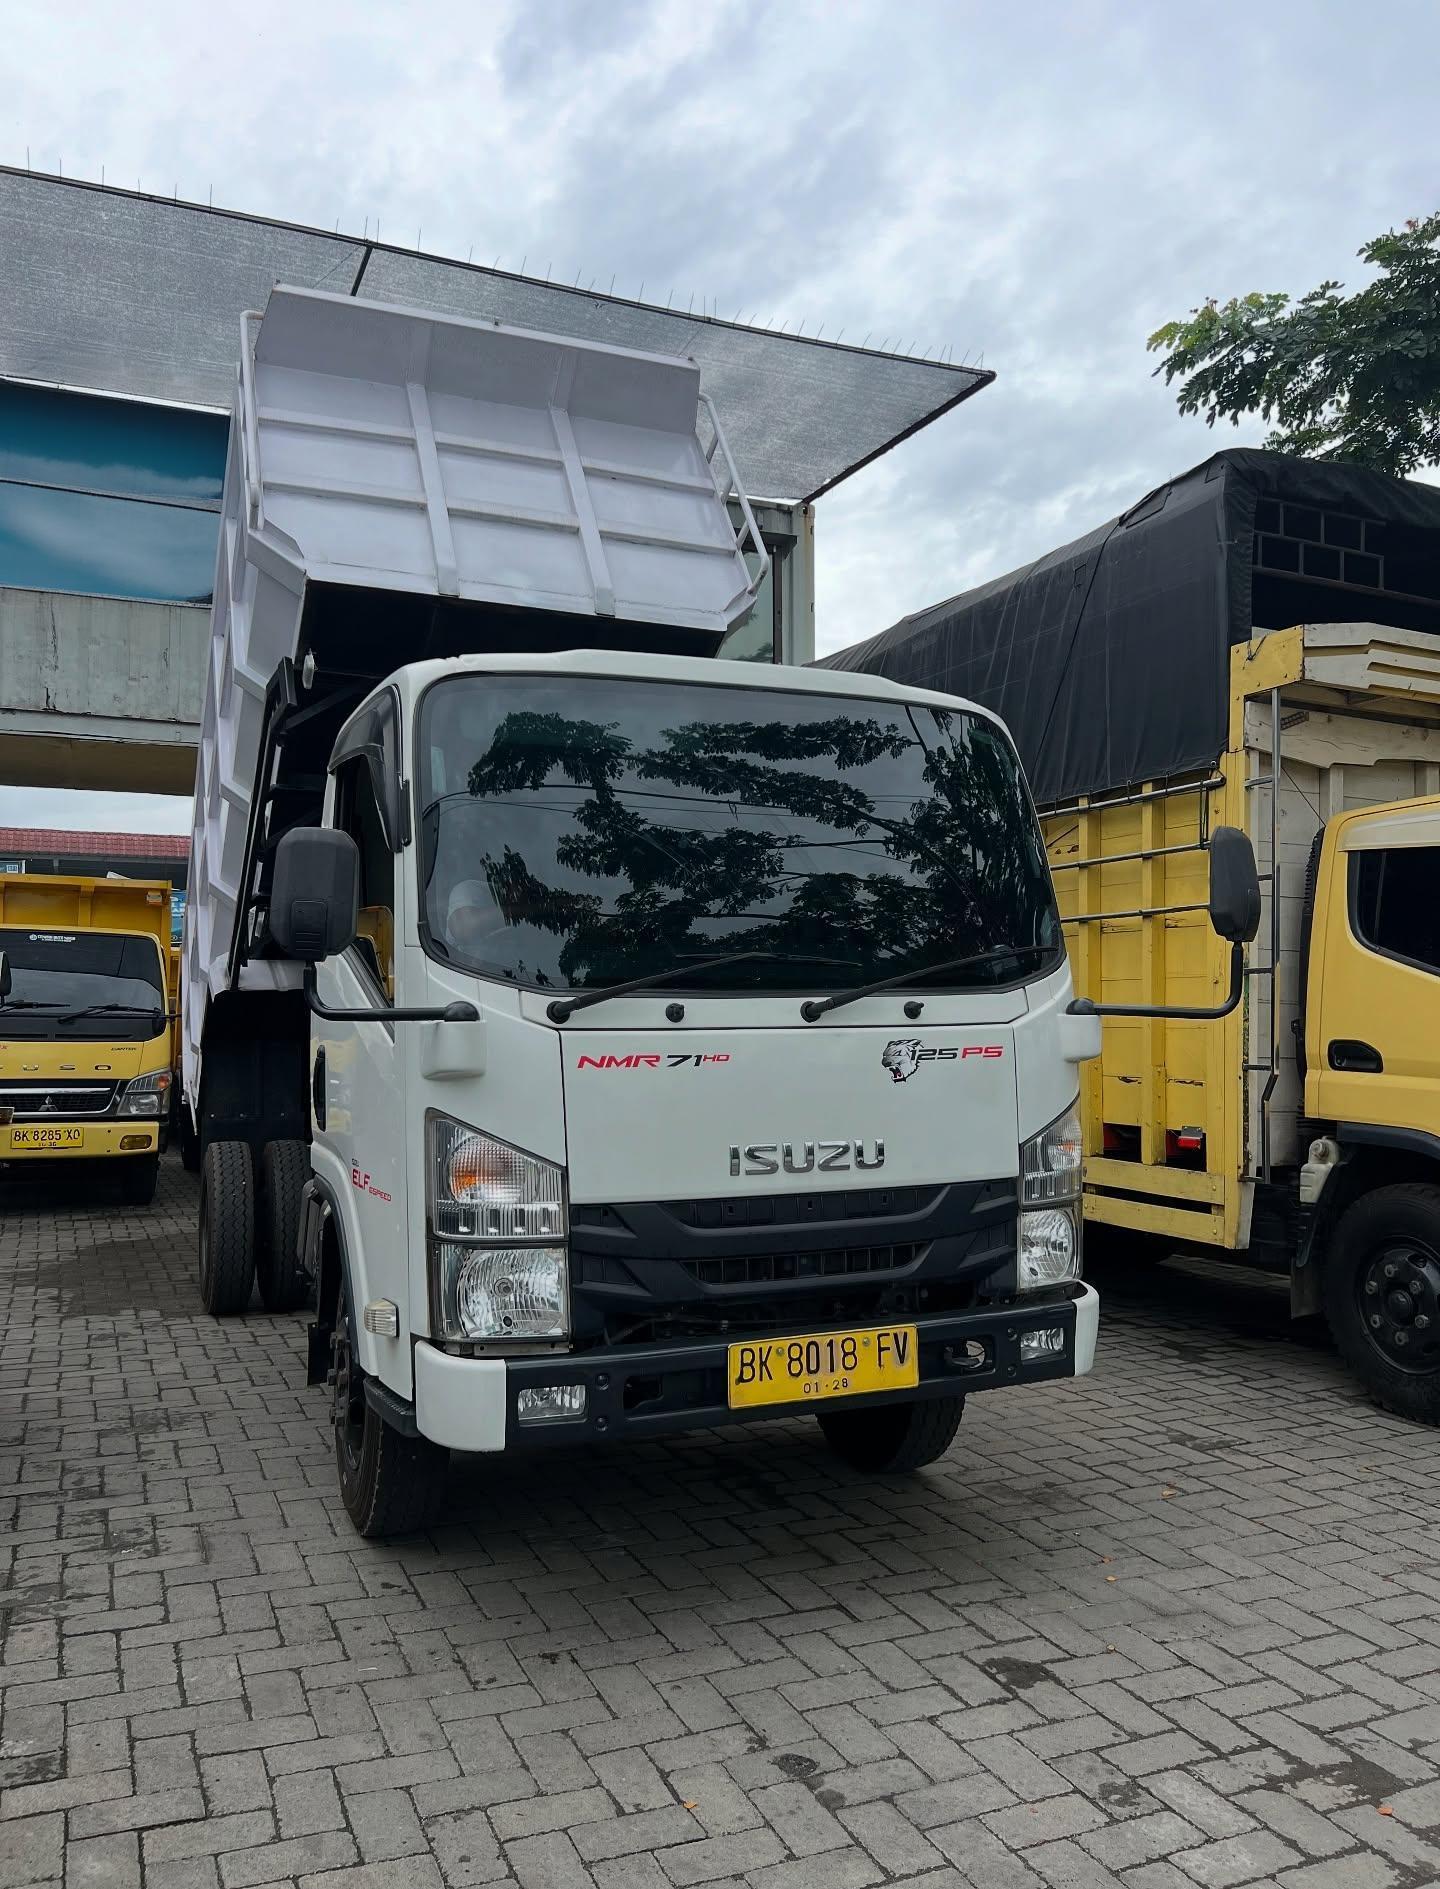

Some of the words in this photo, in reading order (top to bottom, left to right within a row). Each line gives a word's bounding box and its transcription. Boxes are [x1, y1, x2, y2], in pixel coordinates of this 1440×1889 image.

[577, 1055, 661, 1069] NMR
[910, 1047, 958, 1061] 125
[961, 1046, 1003, 1059] PS
[14, 1130, 30, 1141] BK
[32, 1129, 61, 1141] 8285
[729, 1138, 885, 1176] ISUZU
[352, 1168, 370, 1190] ELF
[738, 1345, 773, 1384] BK
[787, 1336, 858, 1377] 8018
[876, 1331, 908, 1369] FV
